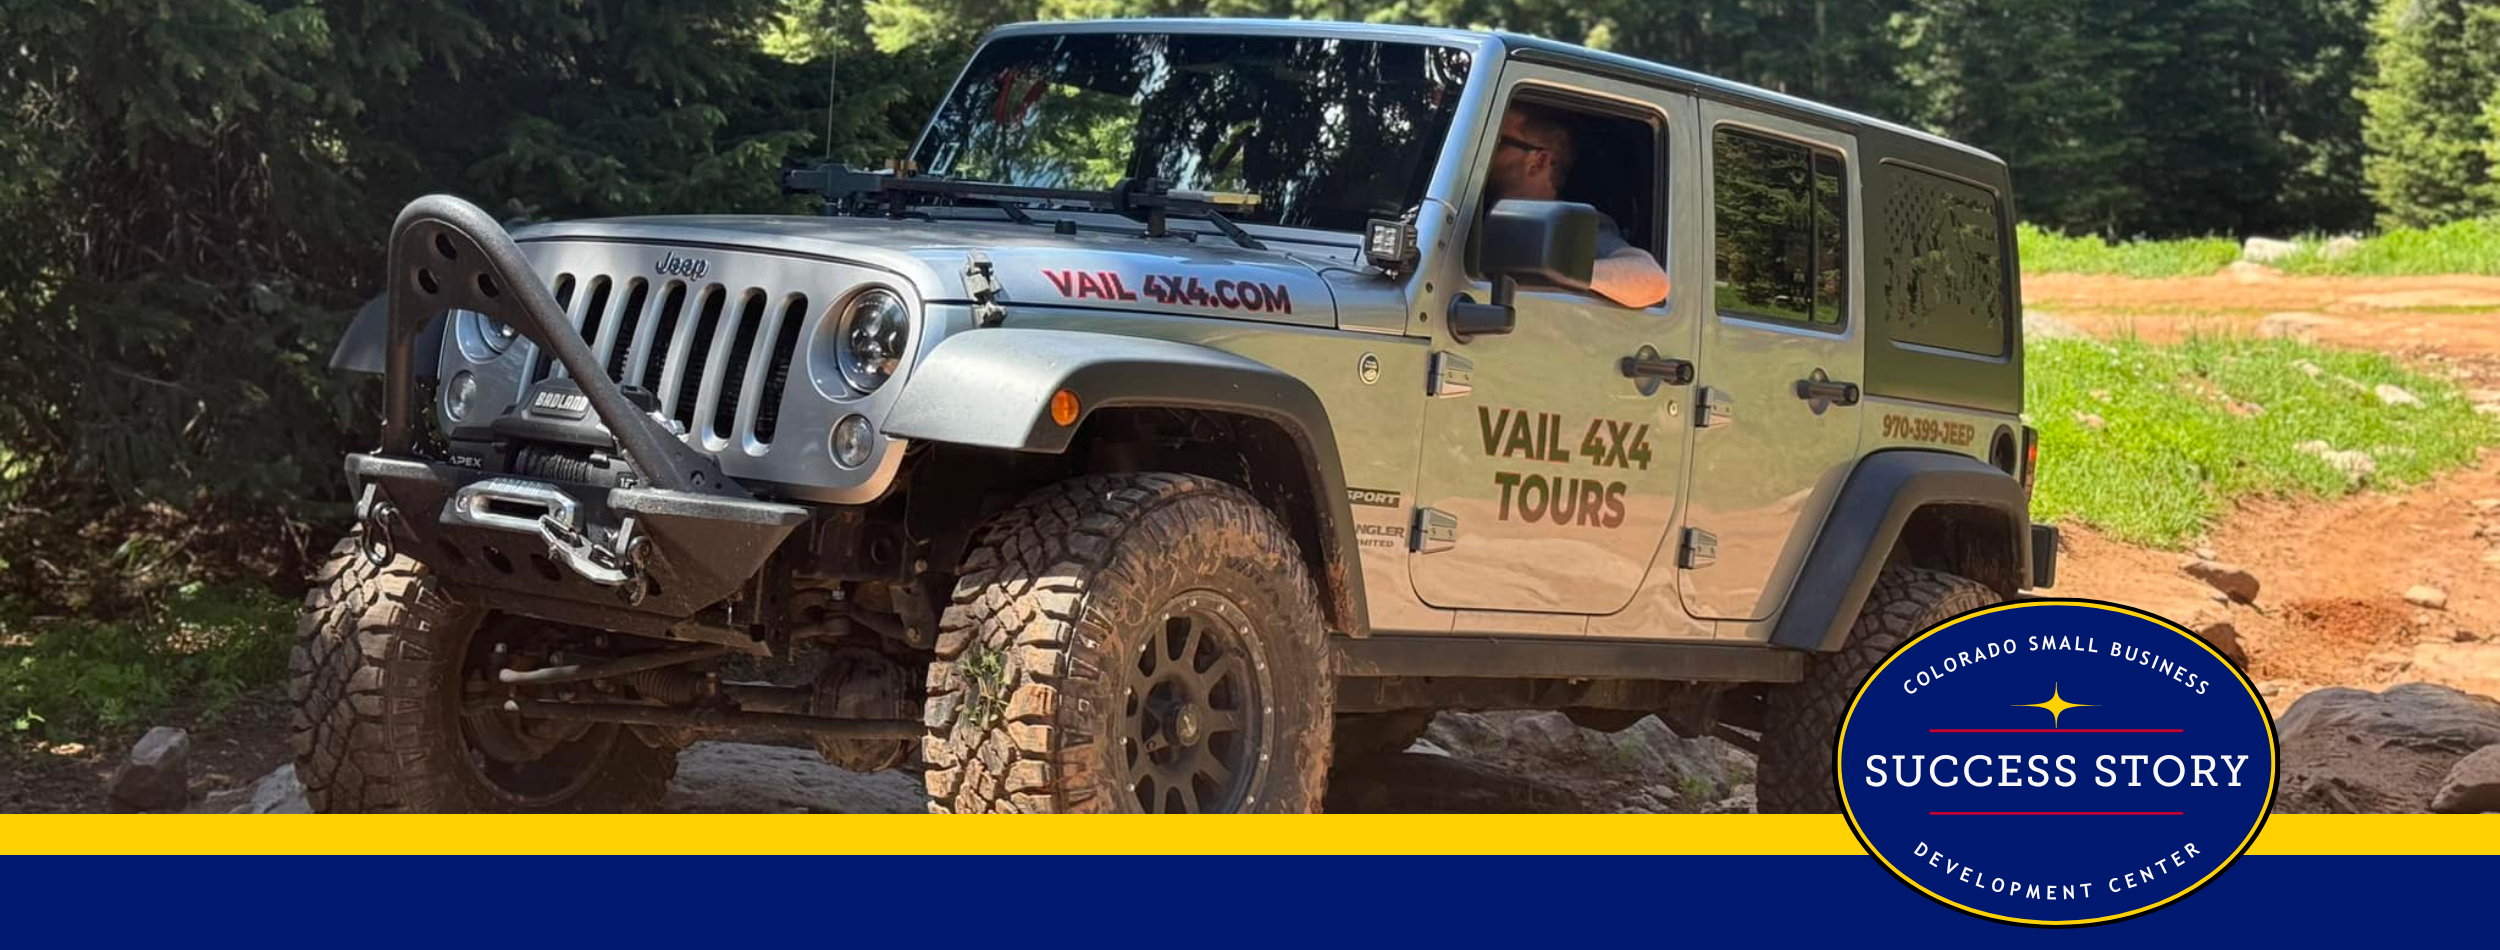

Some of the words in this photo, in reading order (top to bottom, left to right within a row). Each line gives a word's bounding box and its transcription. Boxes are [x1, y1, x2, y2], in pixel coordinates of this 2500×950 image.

[655, 251, 709, 281] Jeep
[1042, 270, 1138, 301] VAIL
[1143, 274, 1293, 315] 4X4.COM
[535, 391, 588, 411] BADLAND
[1478, 405, 1571, 464] VAIL
[1580, 418, 1652, 471] 4X4
[1882, 413, 1975, 447] 970-399-JEEP
[1494, 471, 1628, 529] TOURS
[1356, 523, 1405, 538] NGLER
